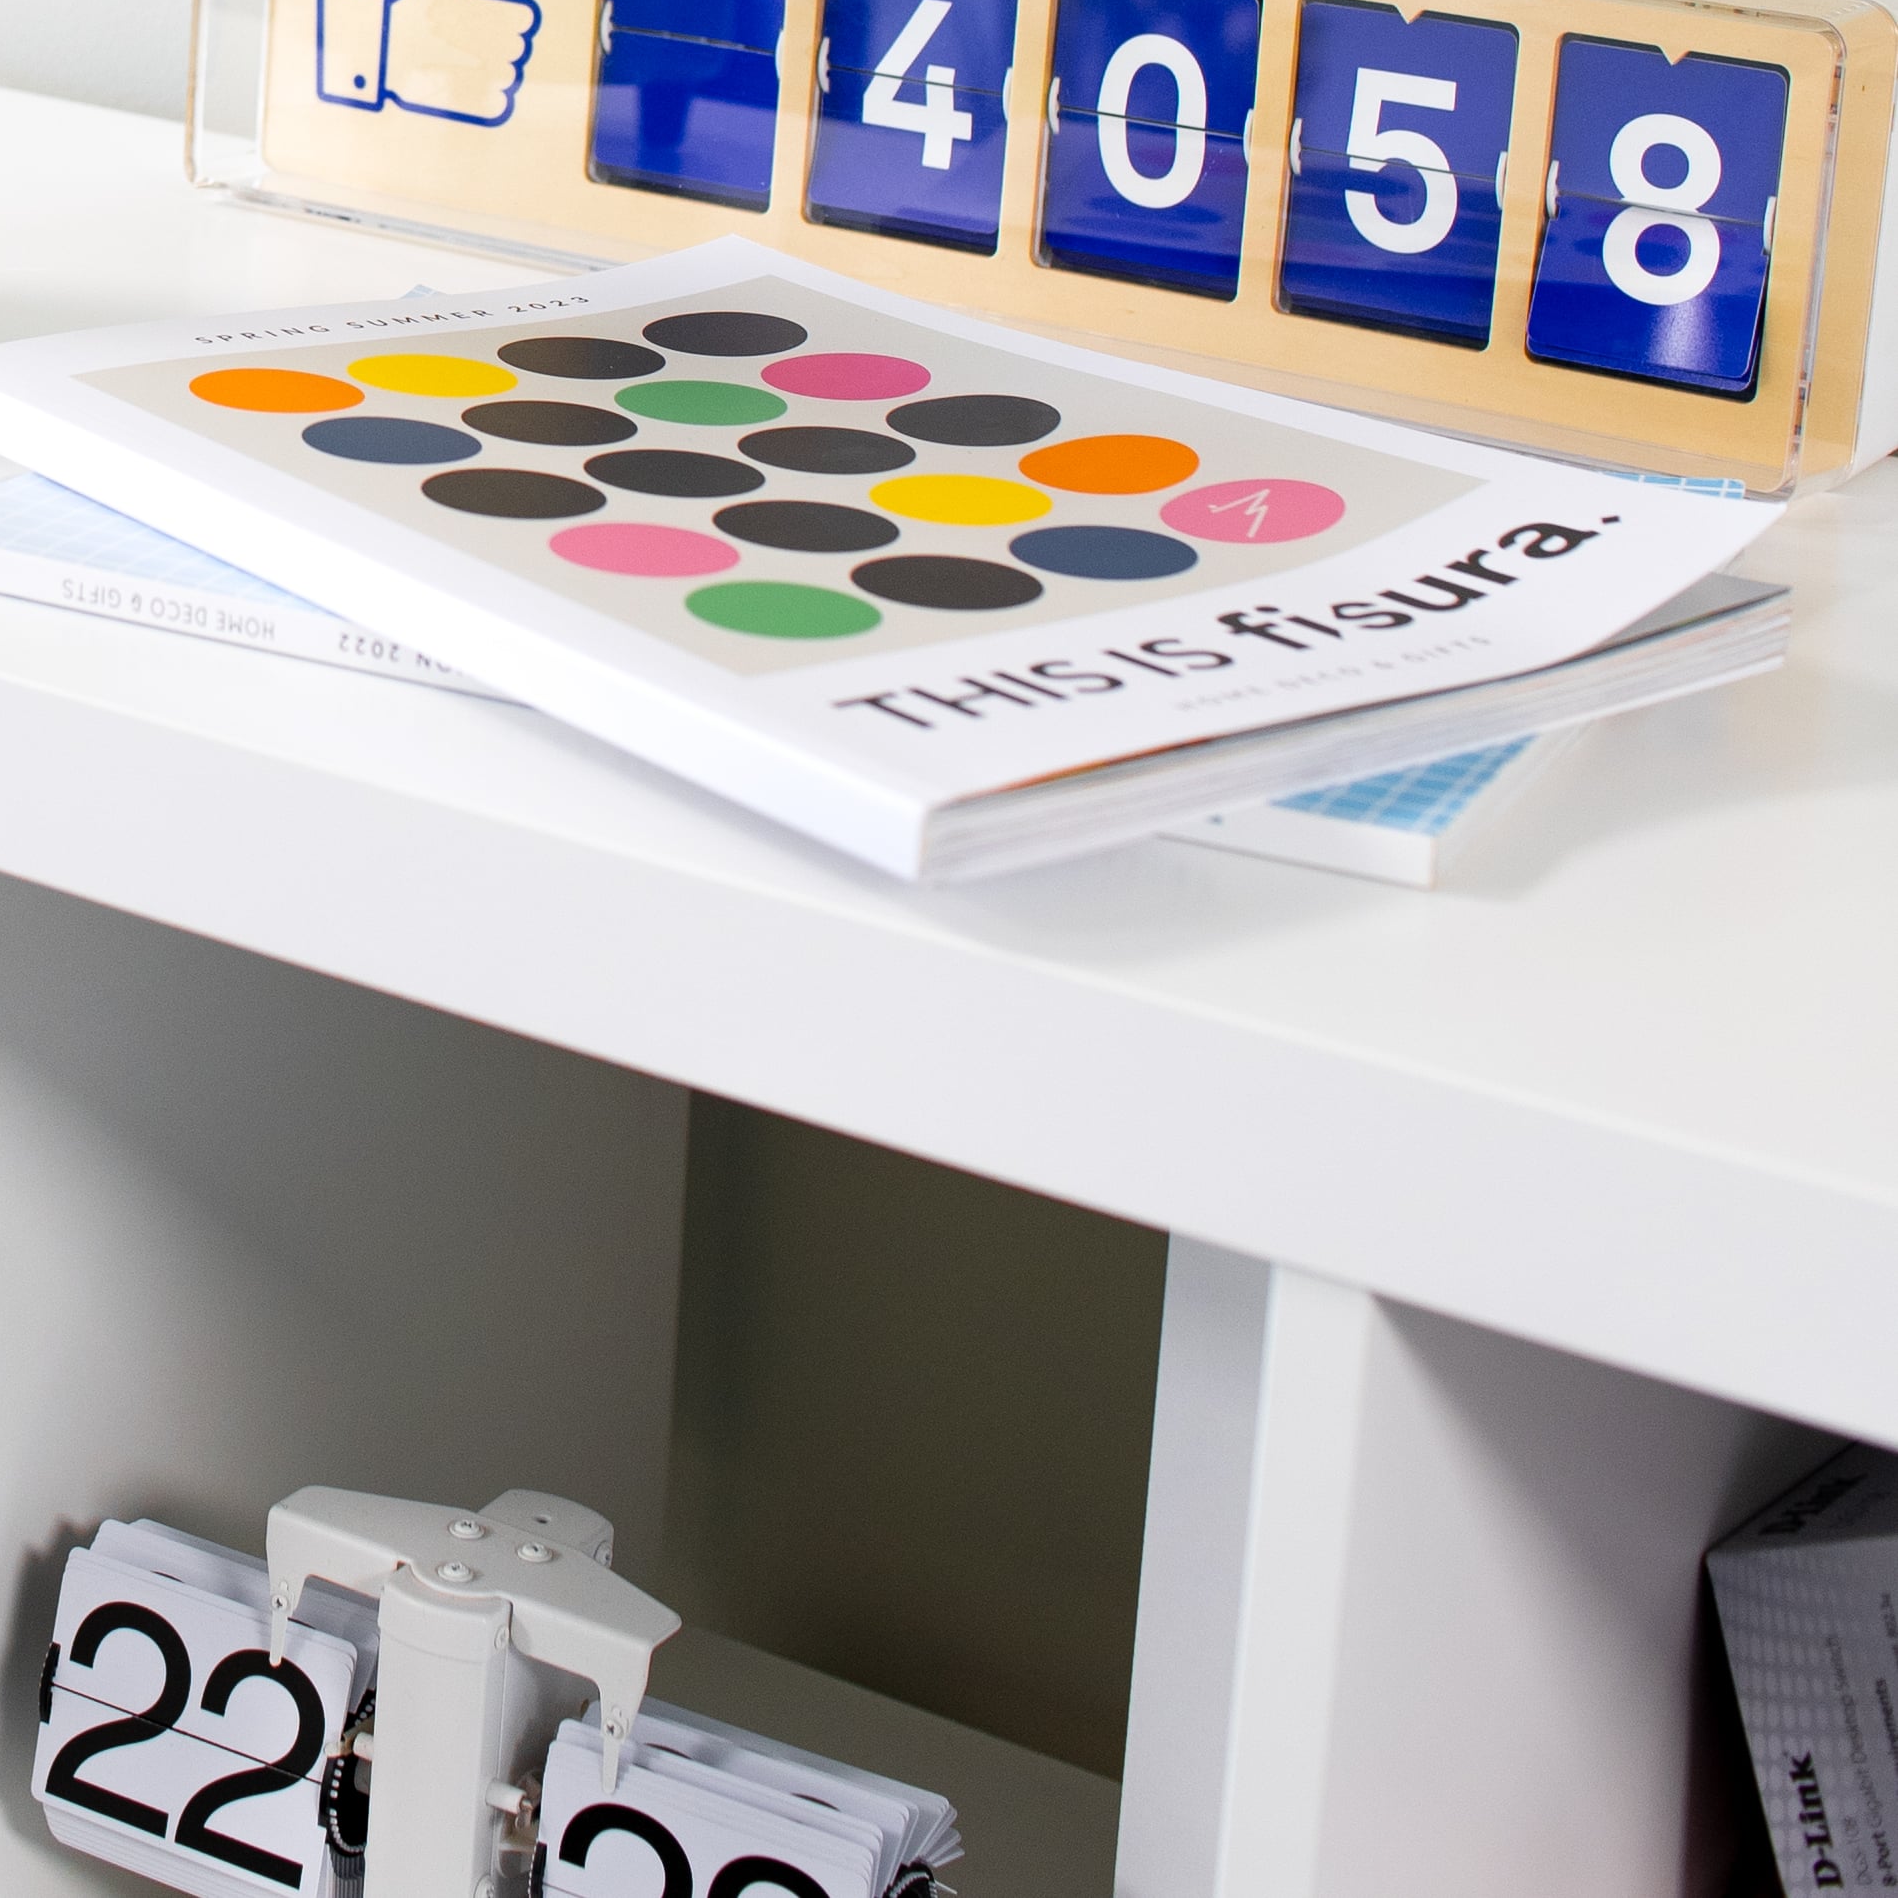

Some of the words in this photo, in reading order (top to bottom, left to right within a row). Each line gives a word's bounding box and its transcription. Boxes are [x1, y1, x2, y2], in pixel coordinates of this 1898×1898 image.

[194, 325, 331, 345] SPRING
[346, 308, 495, 330] SUMMER
[507, 296, 590, 314] 2023
[60, 577, 122, 611] GIFTS
[149, 595, 209, 629] DECO
[215, 608, 276, 642] HOME
[833, 659, 1124, 729] THIS
[1103, 637, 1233, 681] IS
[1216, 513, 1623, 651] fisura.
[337, 632, 401, 664] 2022
[45, 1600, 326, 1891] 22
[1787, 1750, 1844, 1890] D-Link
